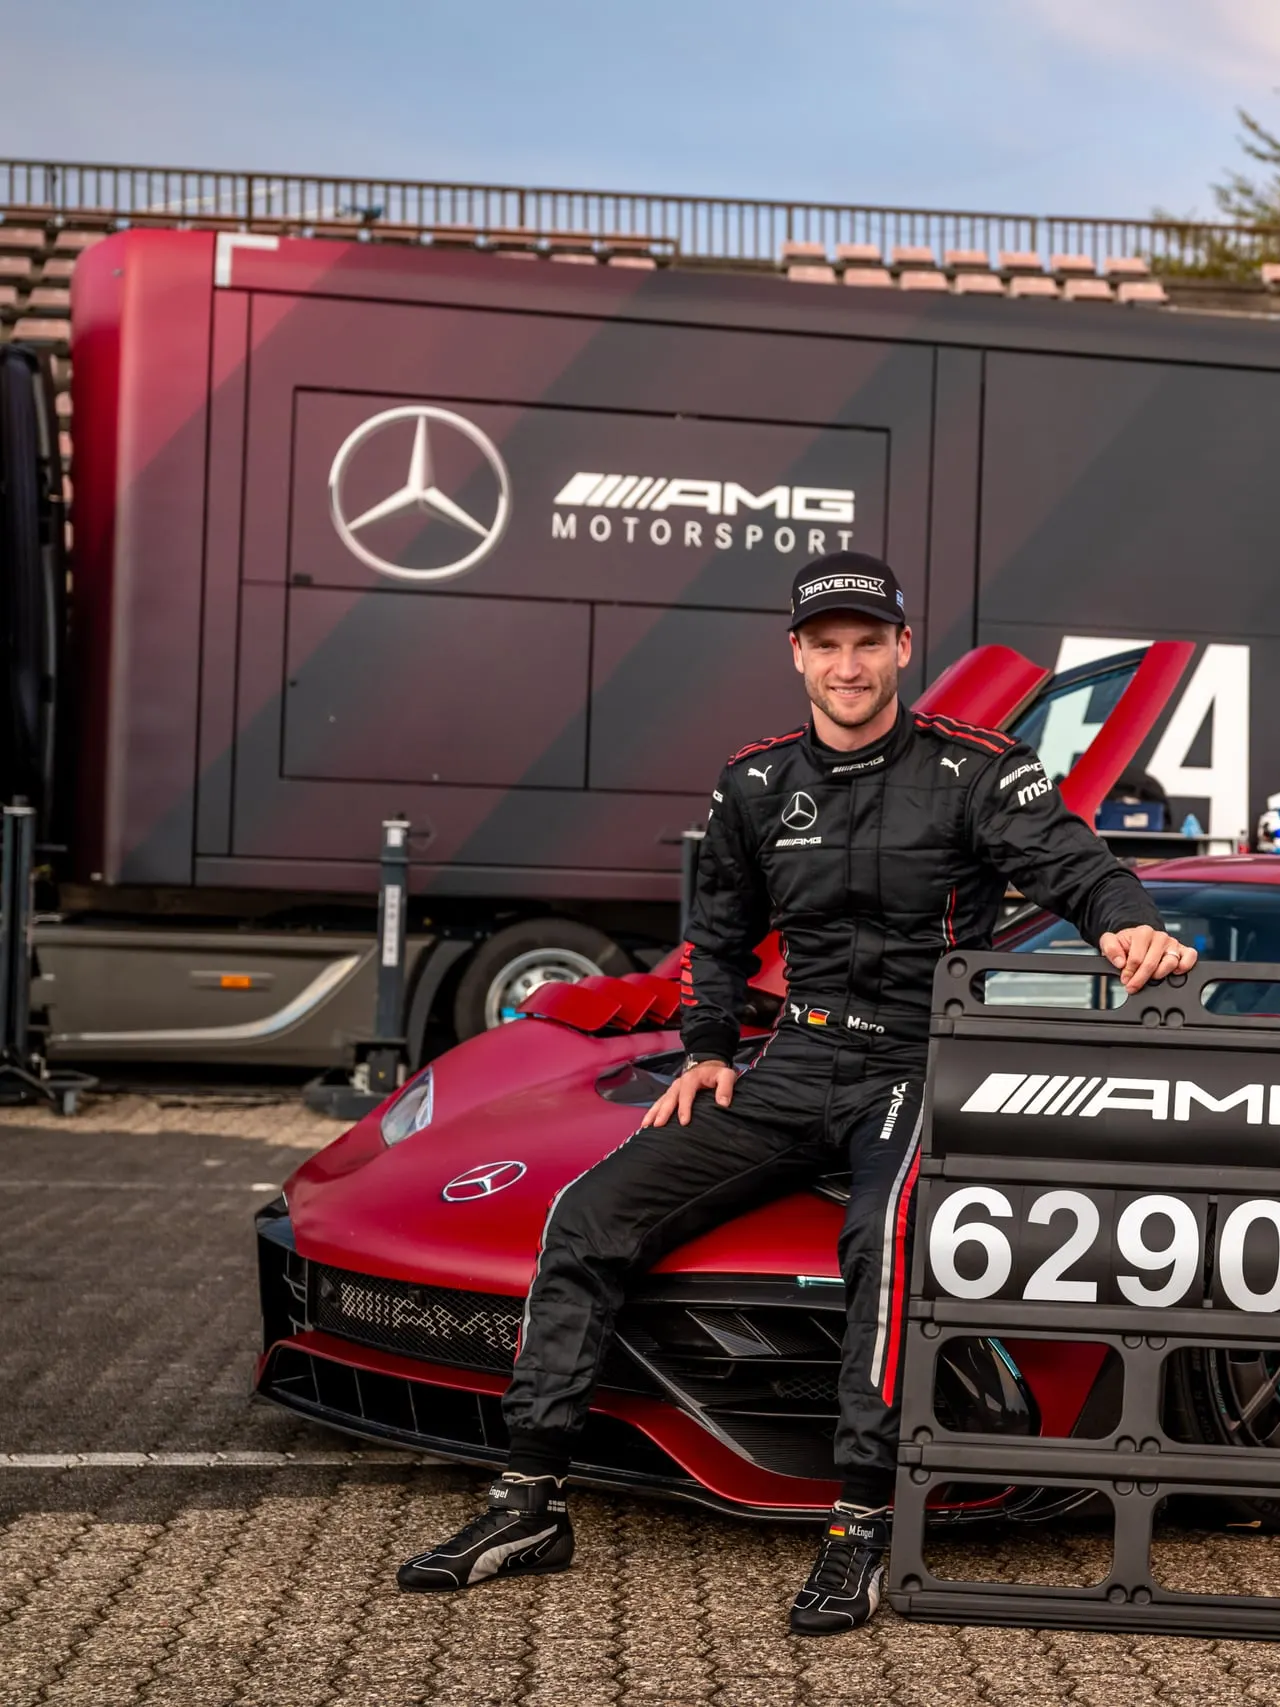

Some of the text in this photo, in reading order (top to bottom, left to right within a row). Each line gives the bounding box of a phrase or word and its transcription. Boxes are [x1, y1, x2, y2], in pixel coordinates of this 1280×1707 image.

[650, 478, 856, 523] AMG
[551, 511, 854, 555] MOTORSPORT
[792, 836, 822, 846] AMG
[847, 1015, 885, 1034] Maro
